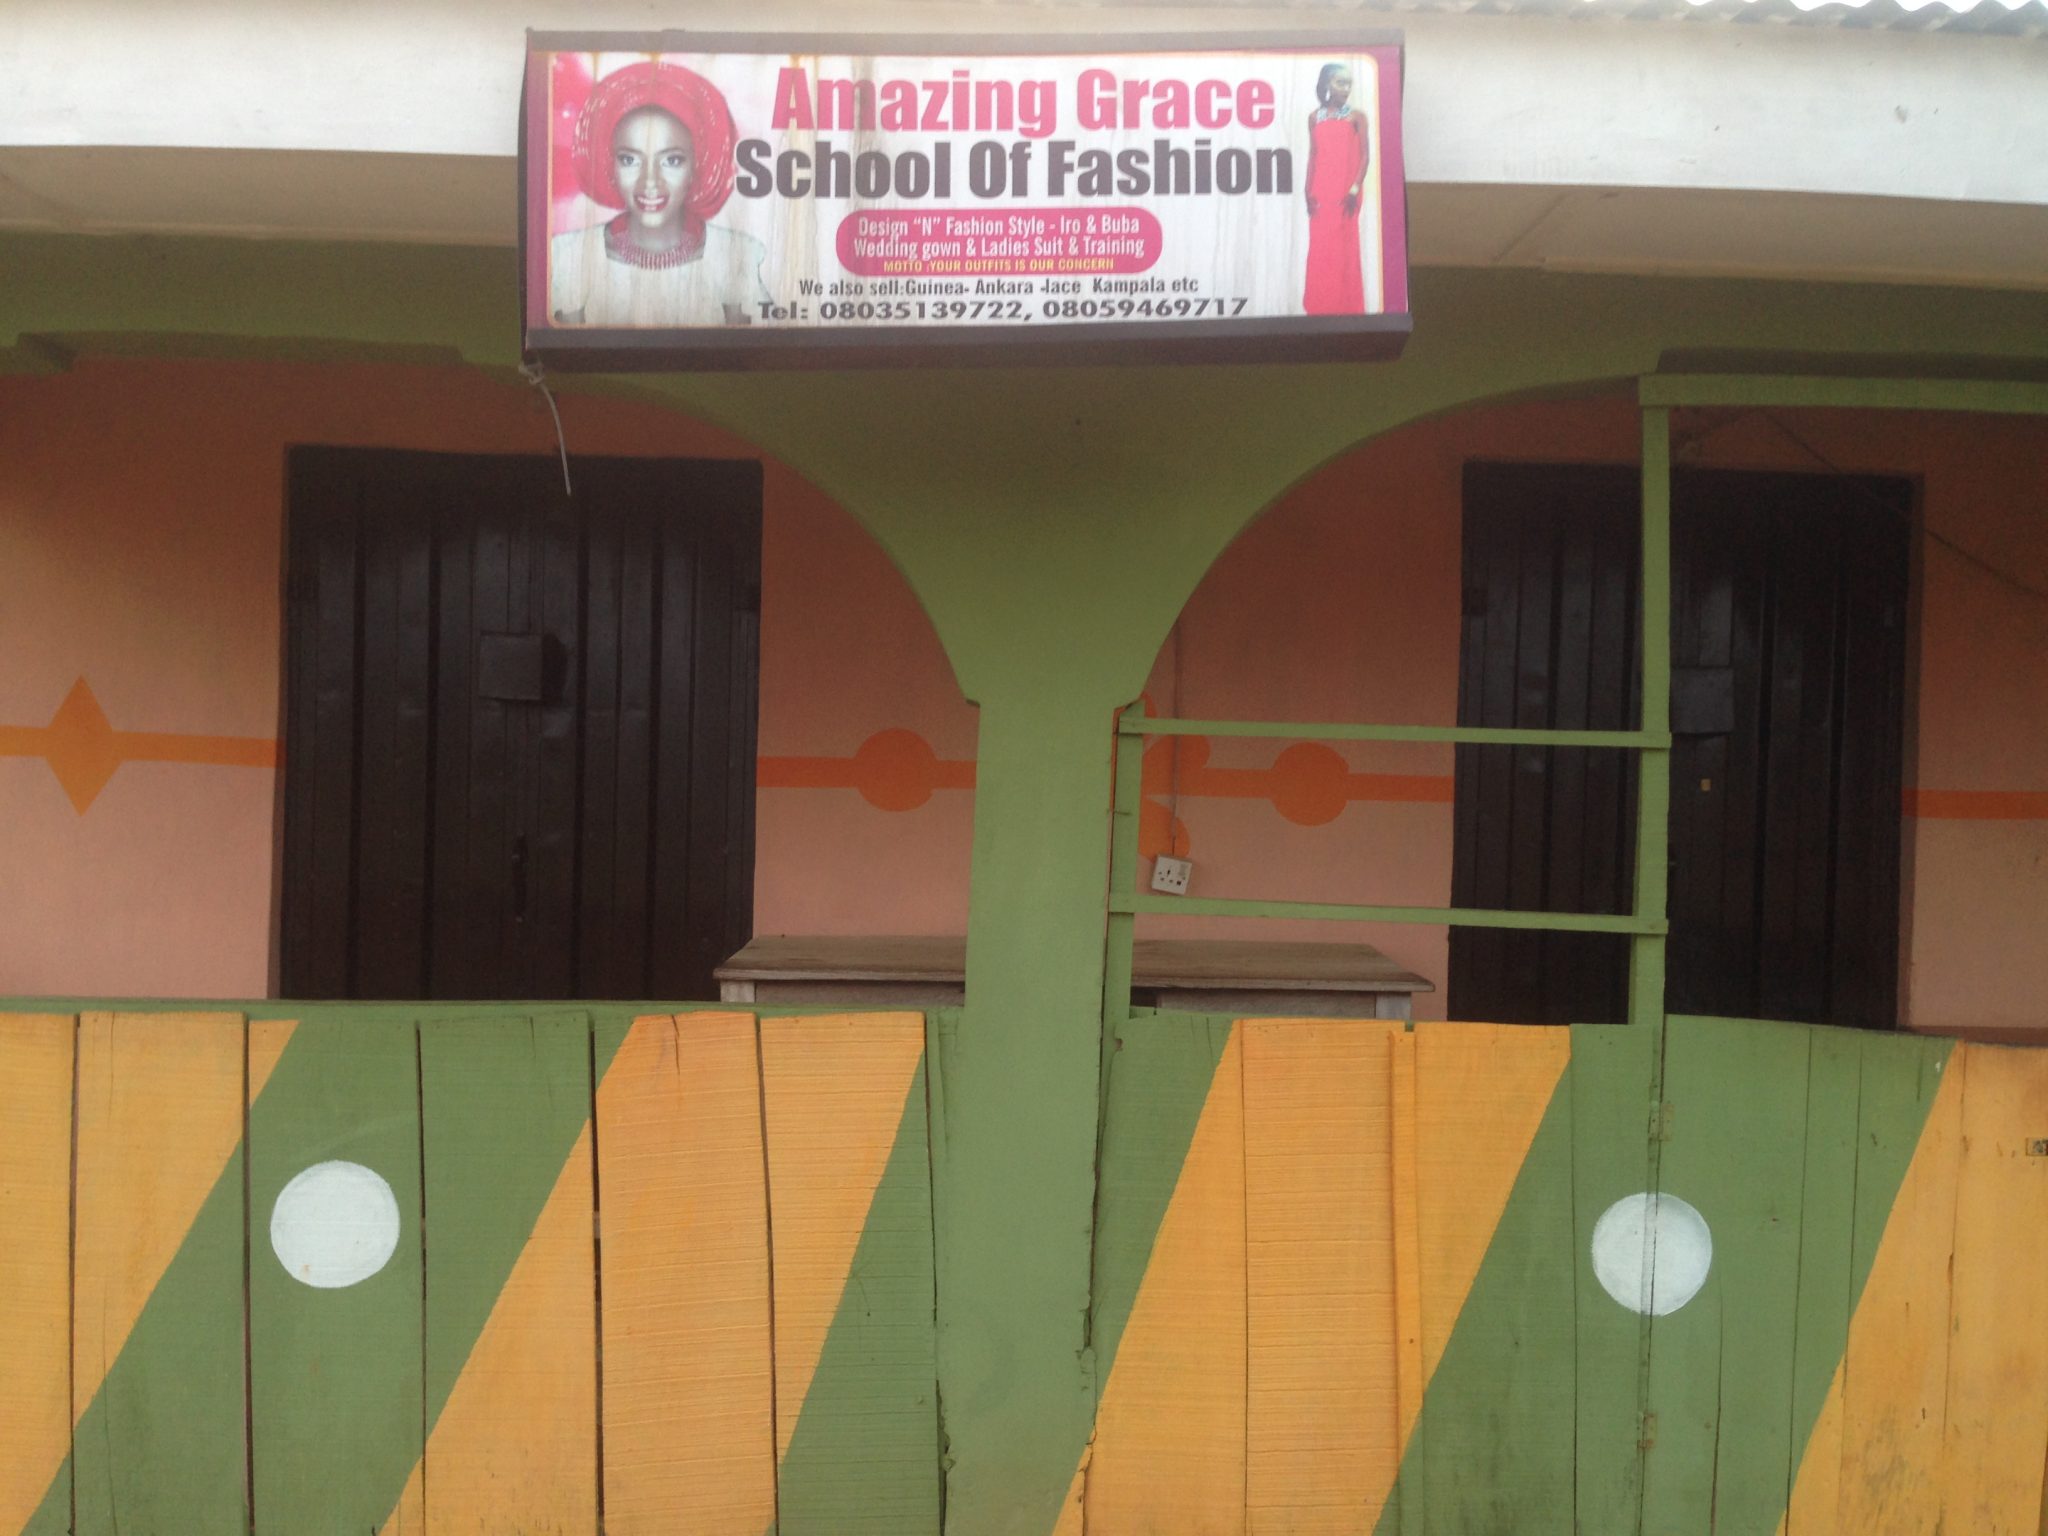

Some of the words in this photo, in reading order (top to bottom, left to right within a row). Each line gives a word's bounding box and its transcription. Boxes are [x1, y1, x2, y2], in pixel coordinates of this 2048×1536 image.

[771, 67, 1057, 138] Amazing
[1077, 69, 1275, 130] Grace
[735, 138, 950, 199] School
[968, 140, 1031, 198] Of
[1048, 138, 1293, 196] Fashion
[858, 217, 908, 241] Design
[946, 216, 1003, 236] Fashion
[1008, 215, 1045, 238] Style
[1060, 215, 1081, 234] Iro
[1086, 215, 1097, 233] &
[1101, 214, 1140, 233] Buba
[854, 238, 917, 260] Wedding
[922, 240, 960, 261] gown
[966, 238, 977, 256] &
[981, 237, 1030, 257] Ladies
[1034, 237, 1063, 256] Suit
[1068, 237, 1079, 255] &
[1083, 237, 1145, 258] Training
[883, 260, 923, 273] MOTTO
[965, 259, 1011, 272] OUTFITS
[1015, 259, 1025, 271] IS
[1030, 259, 1054, 271] OUR
[1058, 258, 1114, 271] CONCERN
[799, 280, 823, 297] We
[829, 279, 863, 296] also
[975, 278, 1034, 294] Ankara
[1093, 277, 1166, 295] Kampala
[1172, 277, 1199, 292] etc
[758, 301, 808, 320] Tel:
[820, 300, 1033, 321] 08035139722,
[1043, 297, 1248, 318] 08059469717
